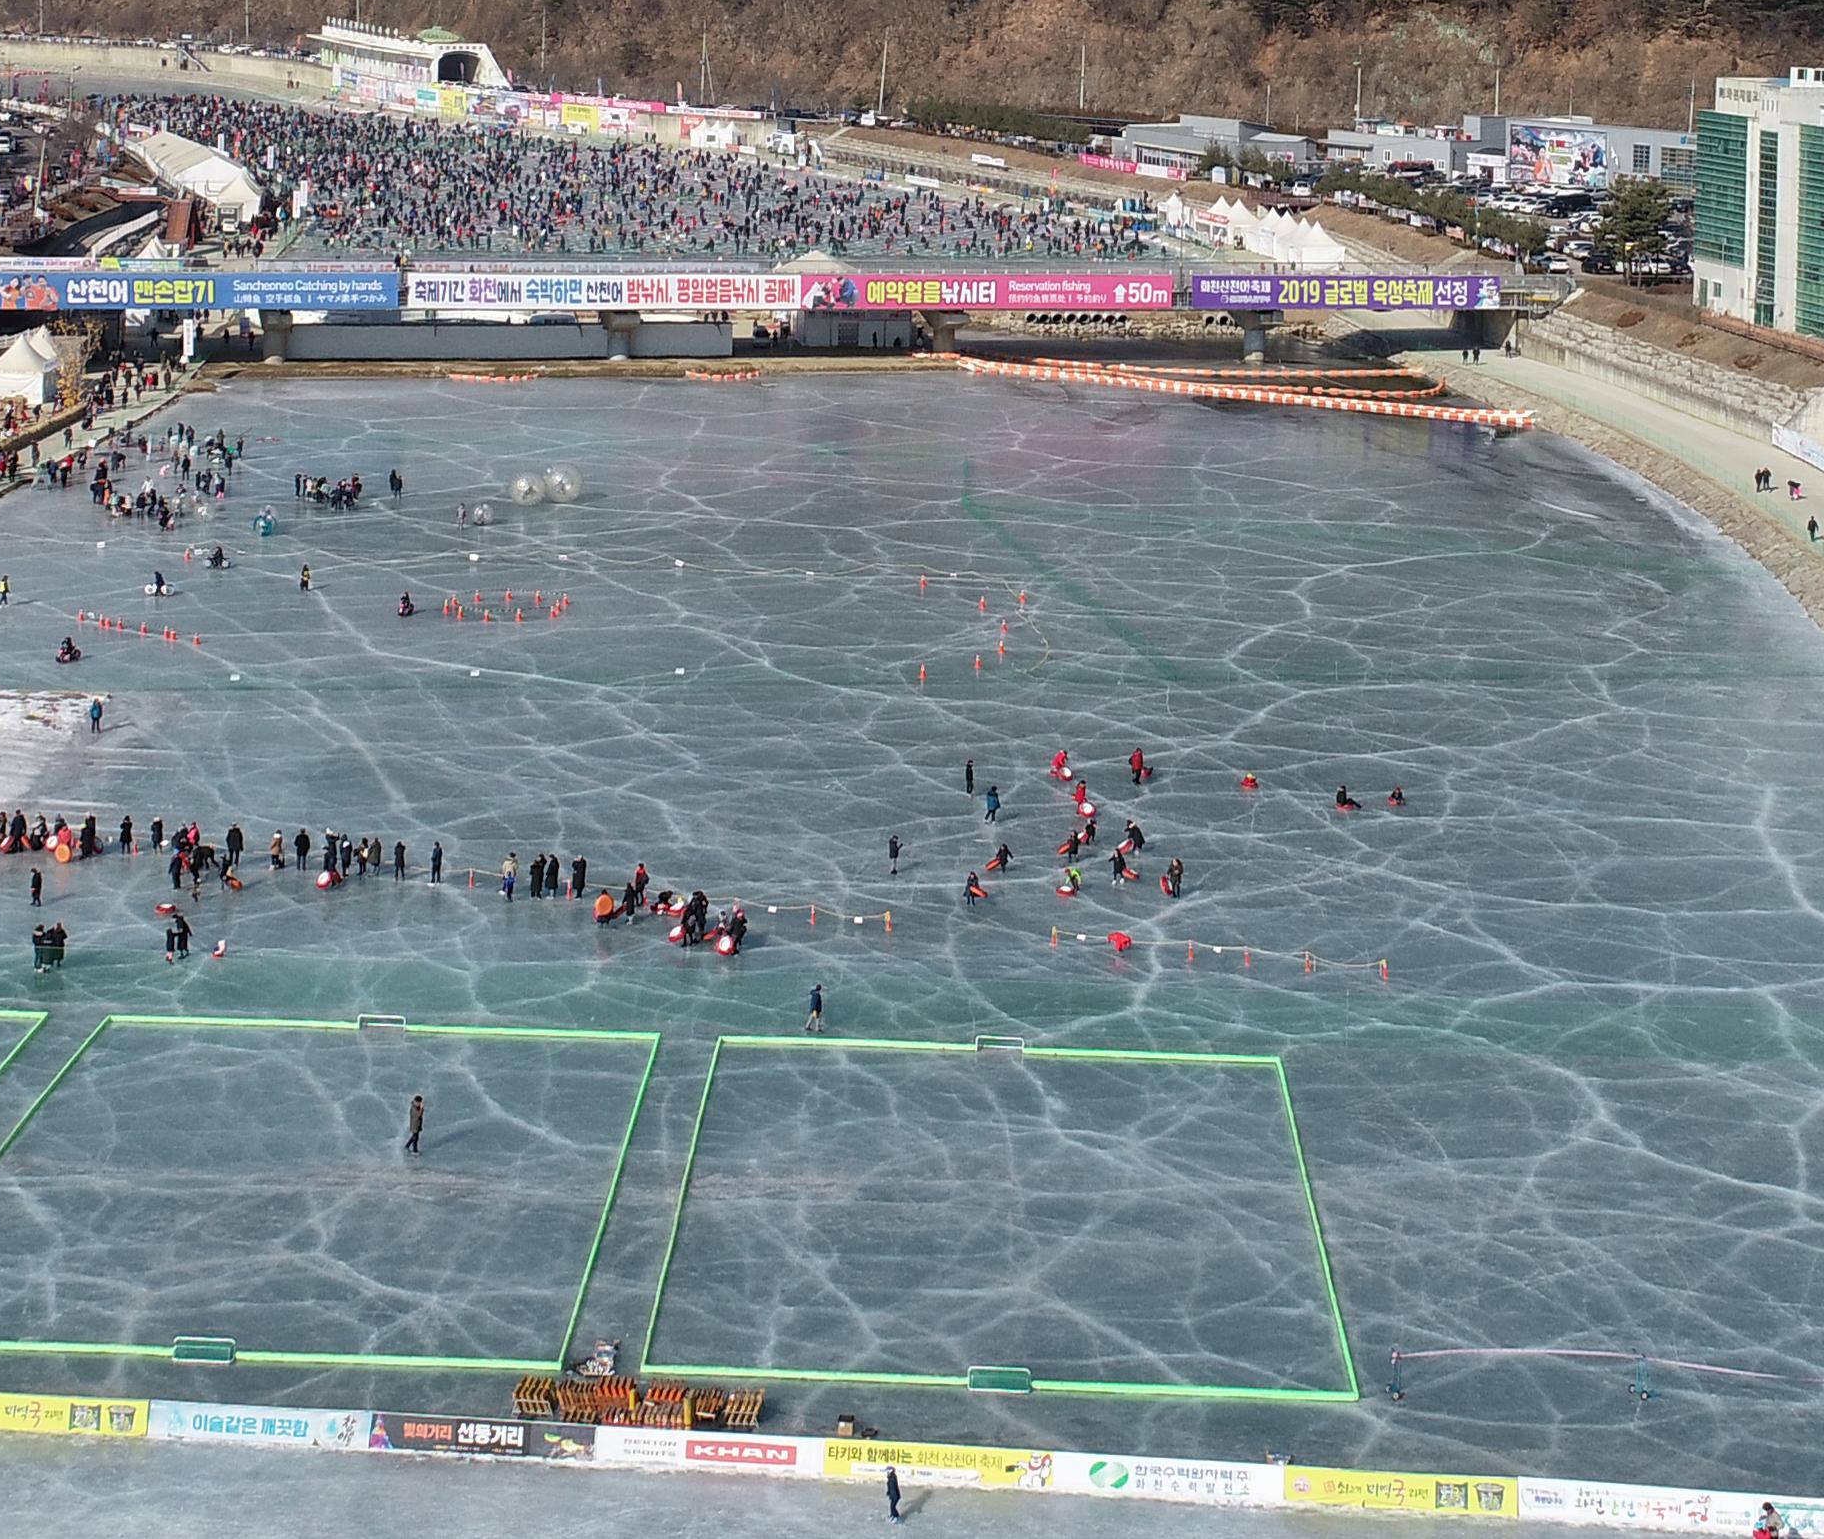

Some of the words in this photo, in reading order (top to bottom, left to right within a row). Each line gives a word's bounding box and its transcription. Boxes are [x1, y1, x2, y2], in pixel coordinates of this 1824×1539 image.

[66, 278, 128, 304] 산천어
[132, 278, 215, 304] 맨손잡기
[295, 279, 338, 294] Catching
[339, 279, 350, 294] by
[350, 279, 383, 291] hands
[415, 280, 465, 304] 축제기간
[468, 278, 522, 304] 화천에서
[526, 278, 582, 304] 숙박하면
[586, 281, 623, 304] 산천어
[626, 278, 673, 305] 밤낚시,
[677, 278, 759, 304] 평일얼음낚시
[764, 279, 795, 304] 공짜!
[867, 280, 996, 304] 예약얼음낚시터
[1008, 280, 1061, 292] Reservation
[1062, 280, 1090, 294] fishing
[1127, 282, 1167, 304] 50m
[1278, 279, 1320, 304] 2019
[1324, 279, 1368, 305] 글로벌
[1434, 279, 1468, 306] 선정
[192, 1413, 257, 1436] 이슬같은
[260, 1417, 310, 1438] 깨끗함
[402, 1422, 452, 1441] 빛의거리
[457, 1422, 524, 1447] 선등거리
[692, 1444, 789, 1461] KHAN
[827, 1445, 862, 1460] 타키와
[867, 1446, 912, 1465] 함께하는
[916, 1449, 940, 1467] 화천
[942, 1451, 977, 1469] 산천어
[979, 1454, 1004, 1471] 축제
